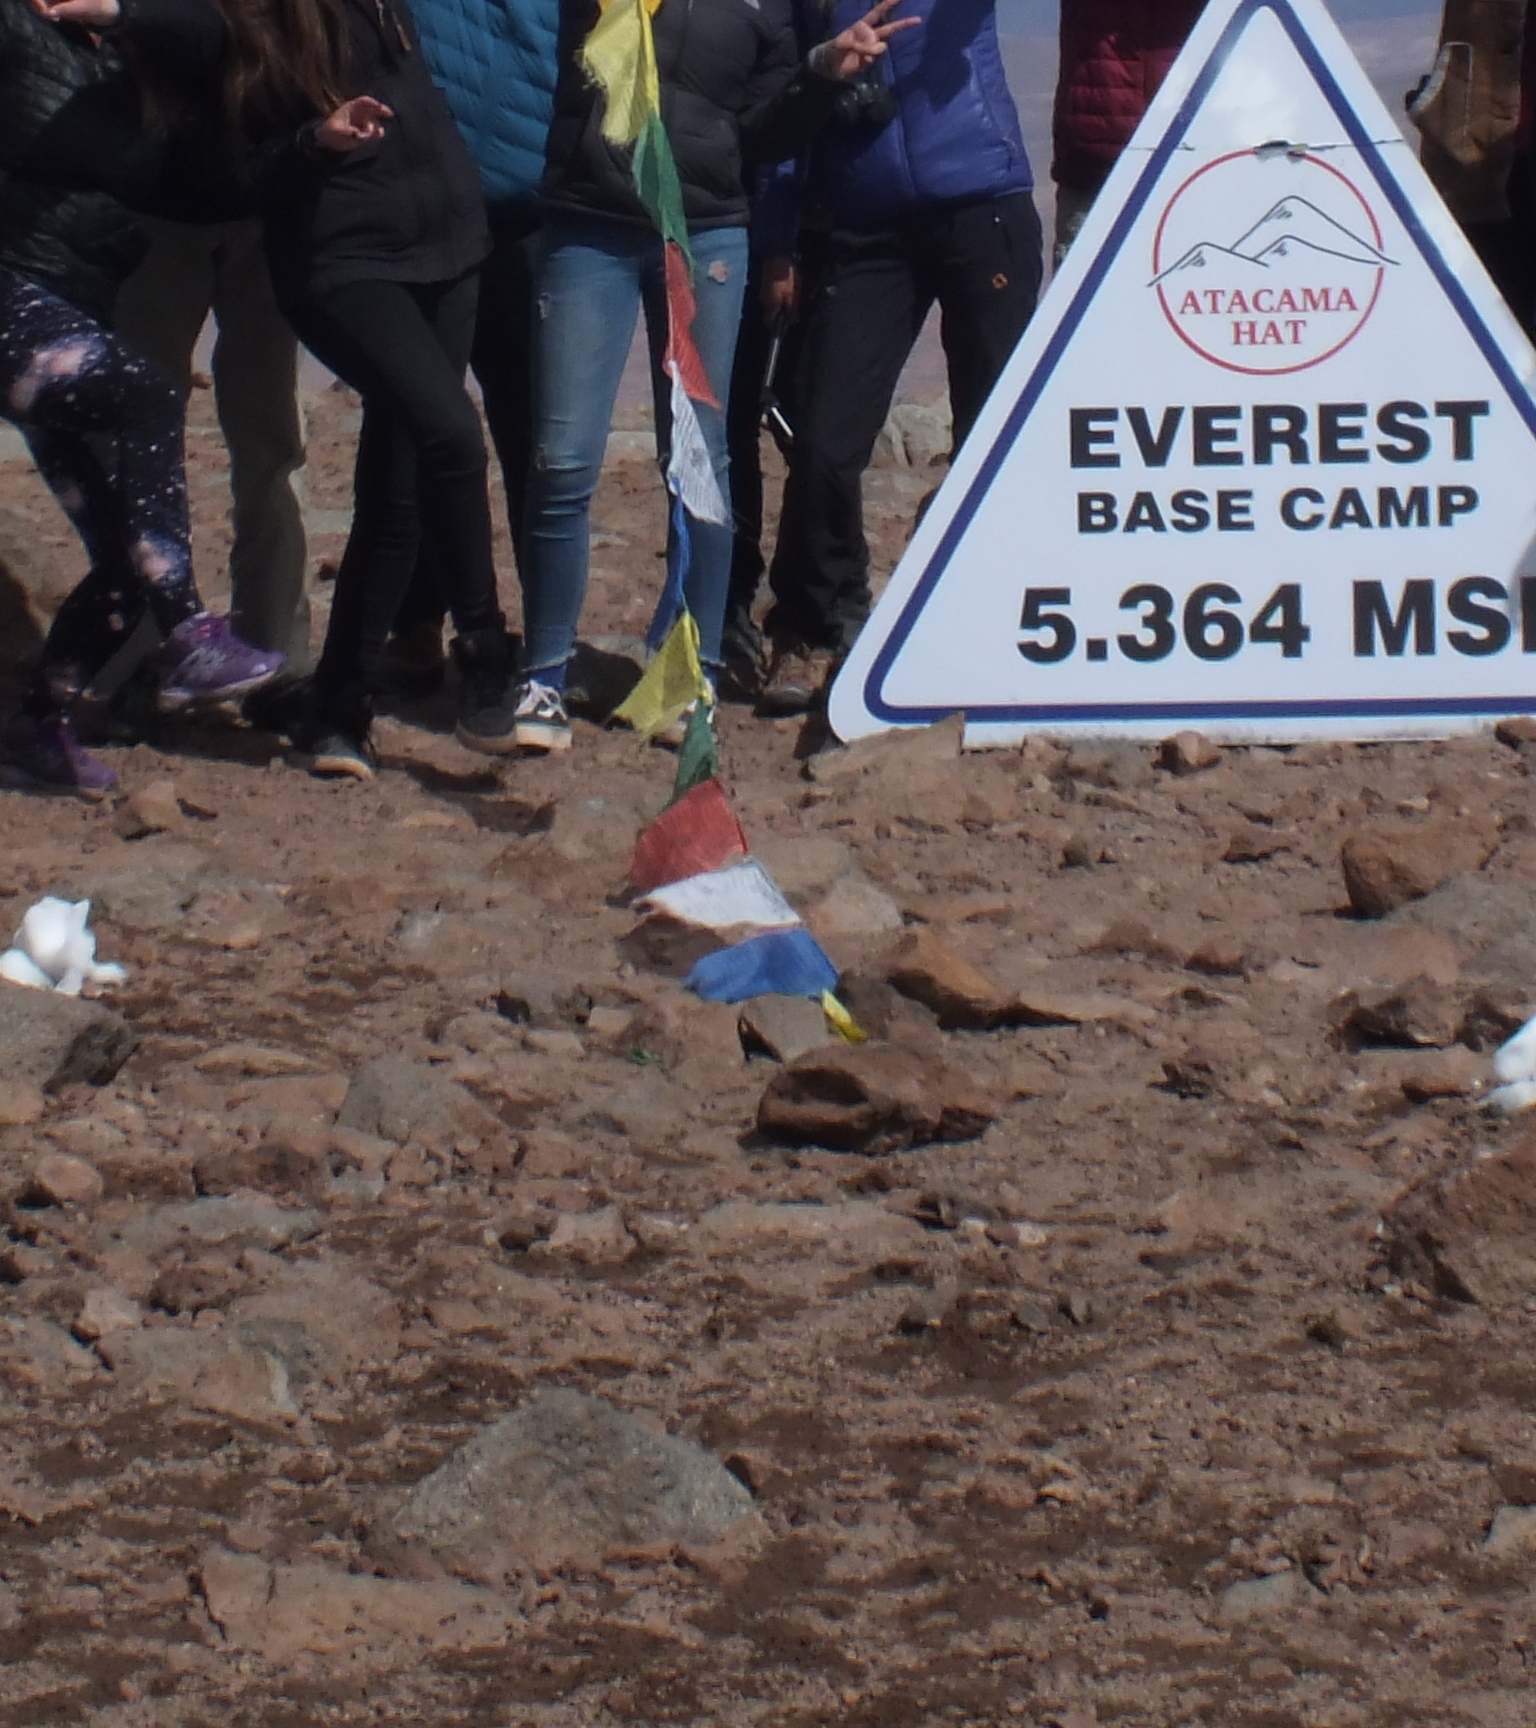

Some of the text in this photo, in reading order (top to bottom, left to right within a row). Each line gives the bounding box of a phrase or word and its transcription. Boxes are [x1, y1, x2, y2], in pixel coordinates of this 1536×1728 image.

[1179, 286, 1359, 315] ATACAMA
[1231, 320, 1307, 346] HAT
[1068, 399, 1490, 469] EVEREST
[1076, 485, 1478, 534] BASE CAMP
[1016, 582, 1310, 663] 5.364
